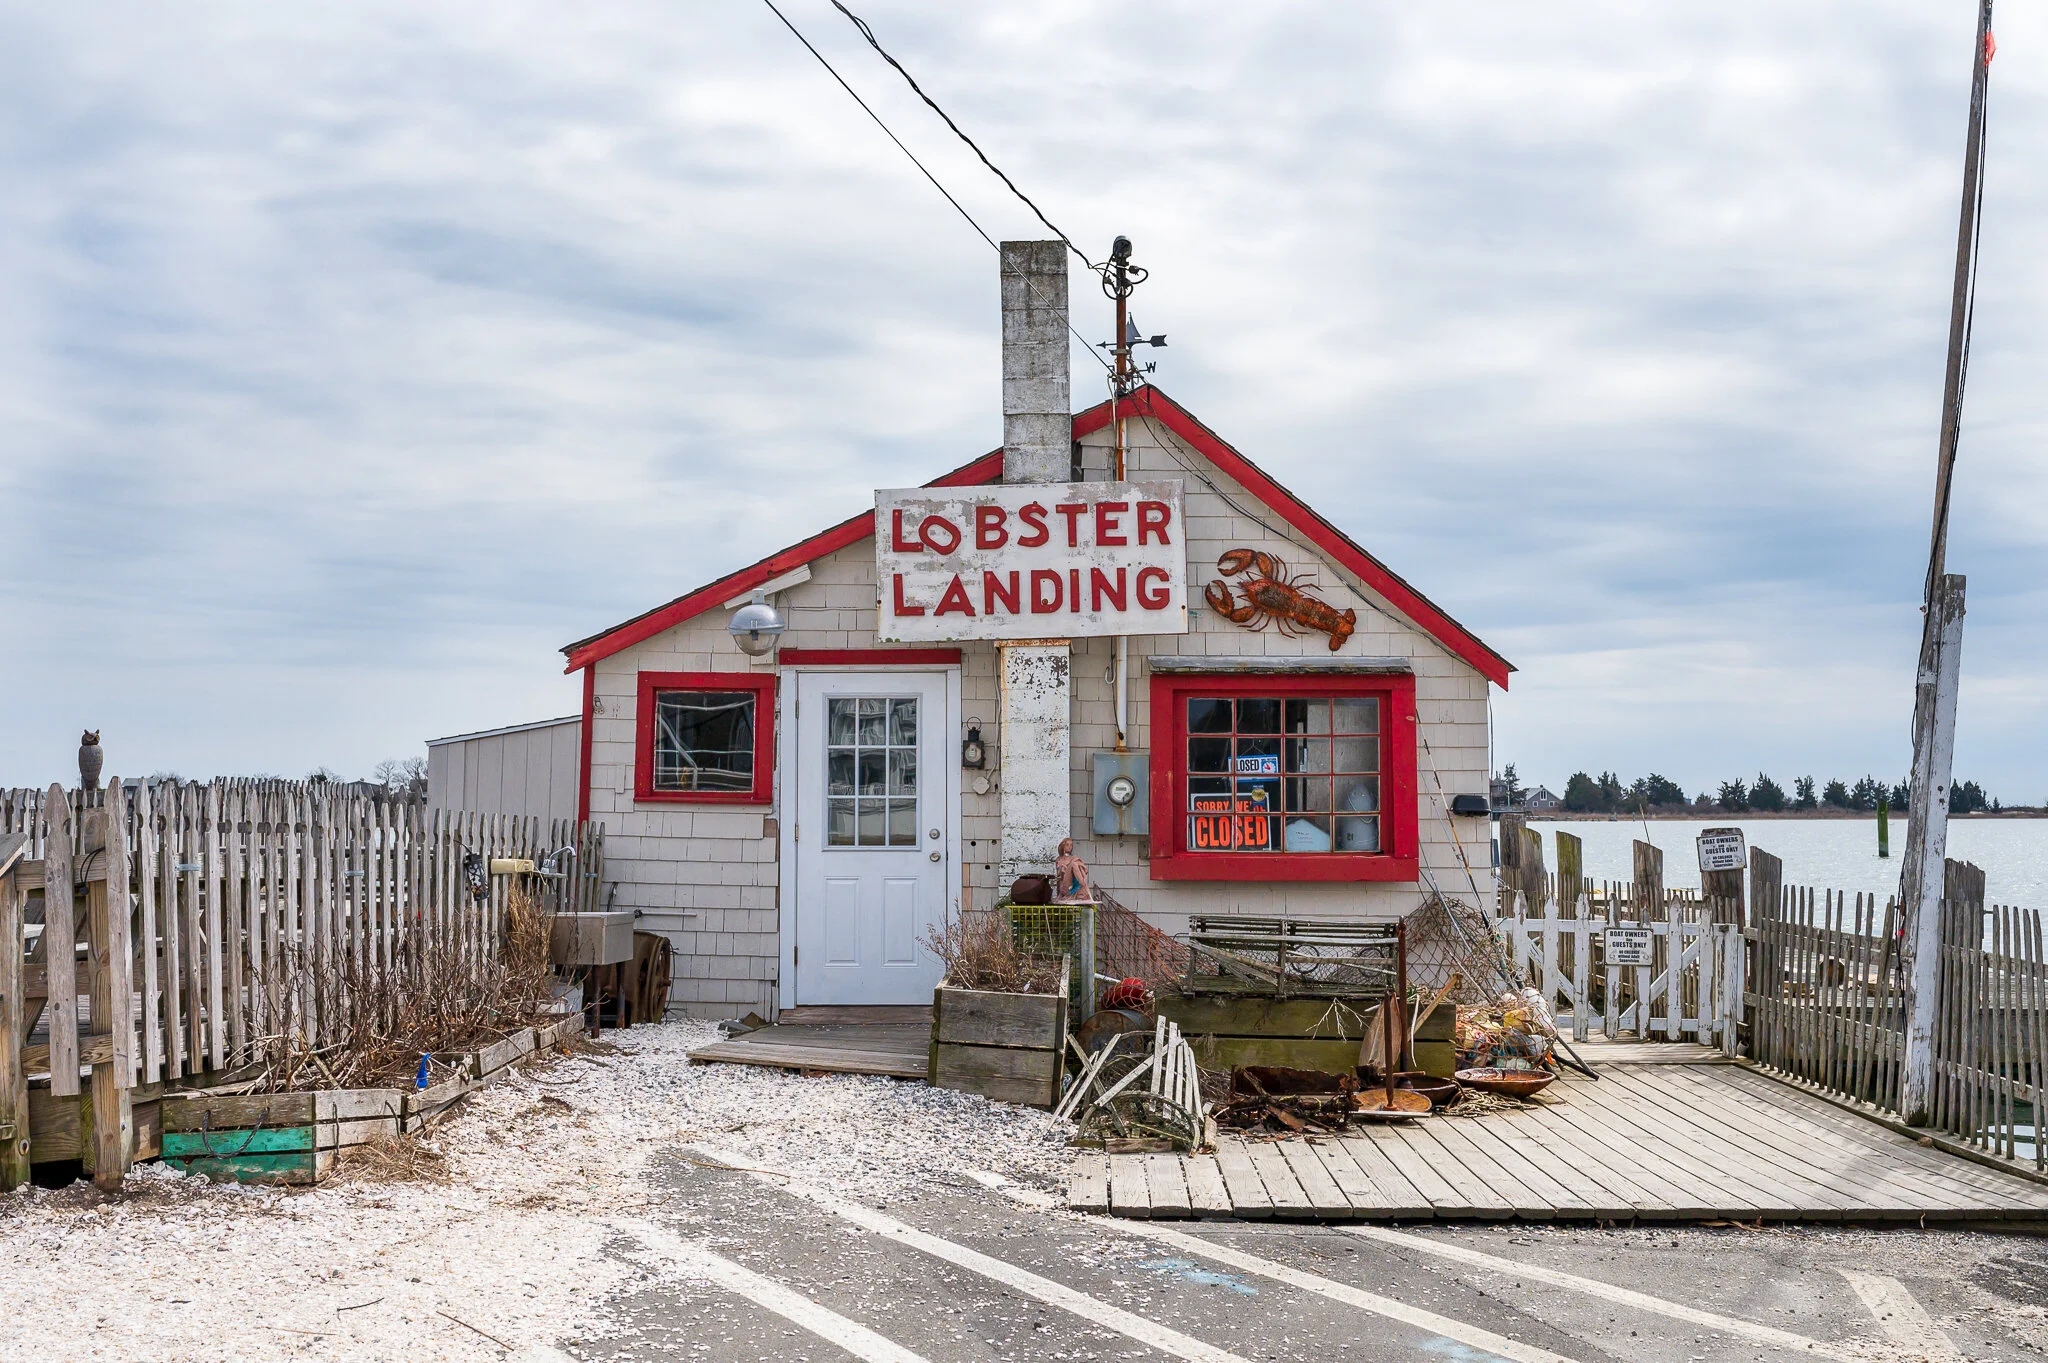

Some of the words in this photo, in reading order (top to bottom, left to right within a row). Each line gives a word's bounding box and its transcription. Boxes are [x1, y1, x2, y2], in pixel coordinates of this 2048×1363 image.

[892, 501, 1171, 555] LOBSTER
[893, 567, 1170, 616] LANDING
[1231, 759, 1260, 771] LOSED
[1196, 816, 1267, 847] CLOSED
